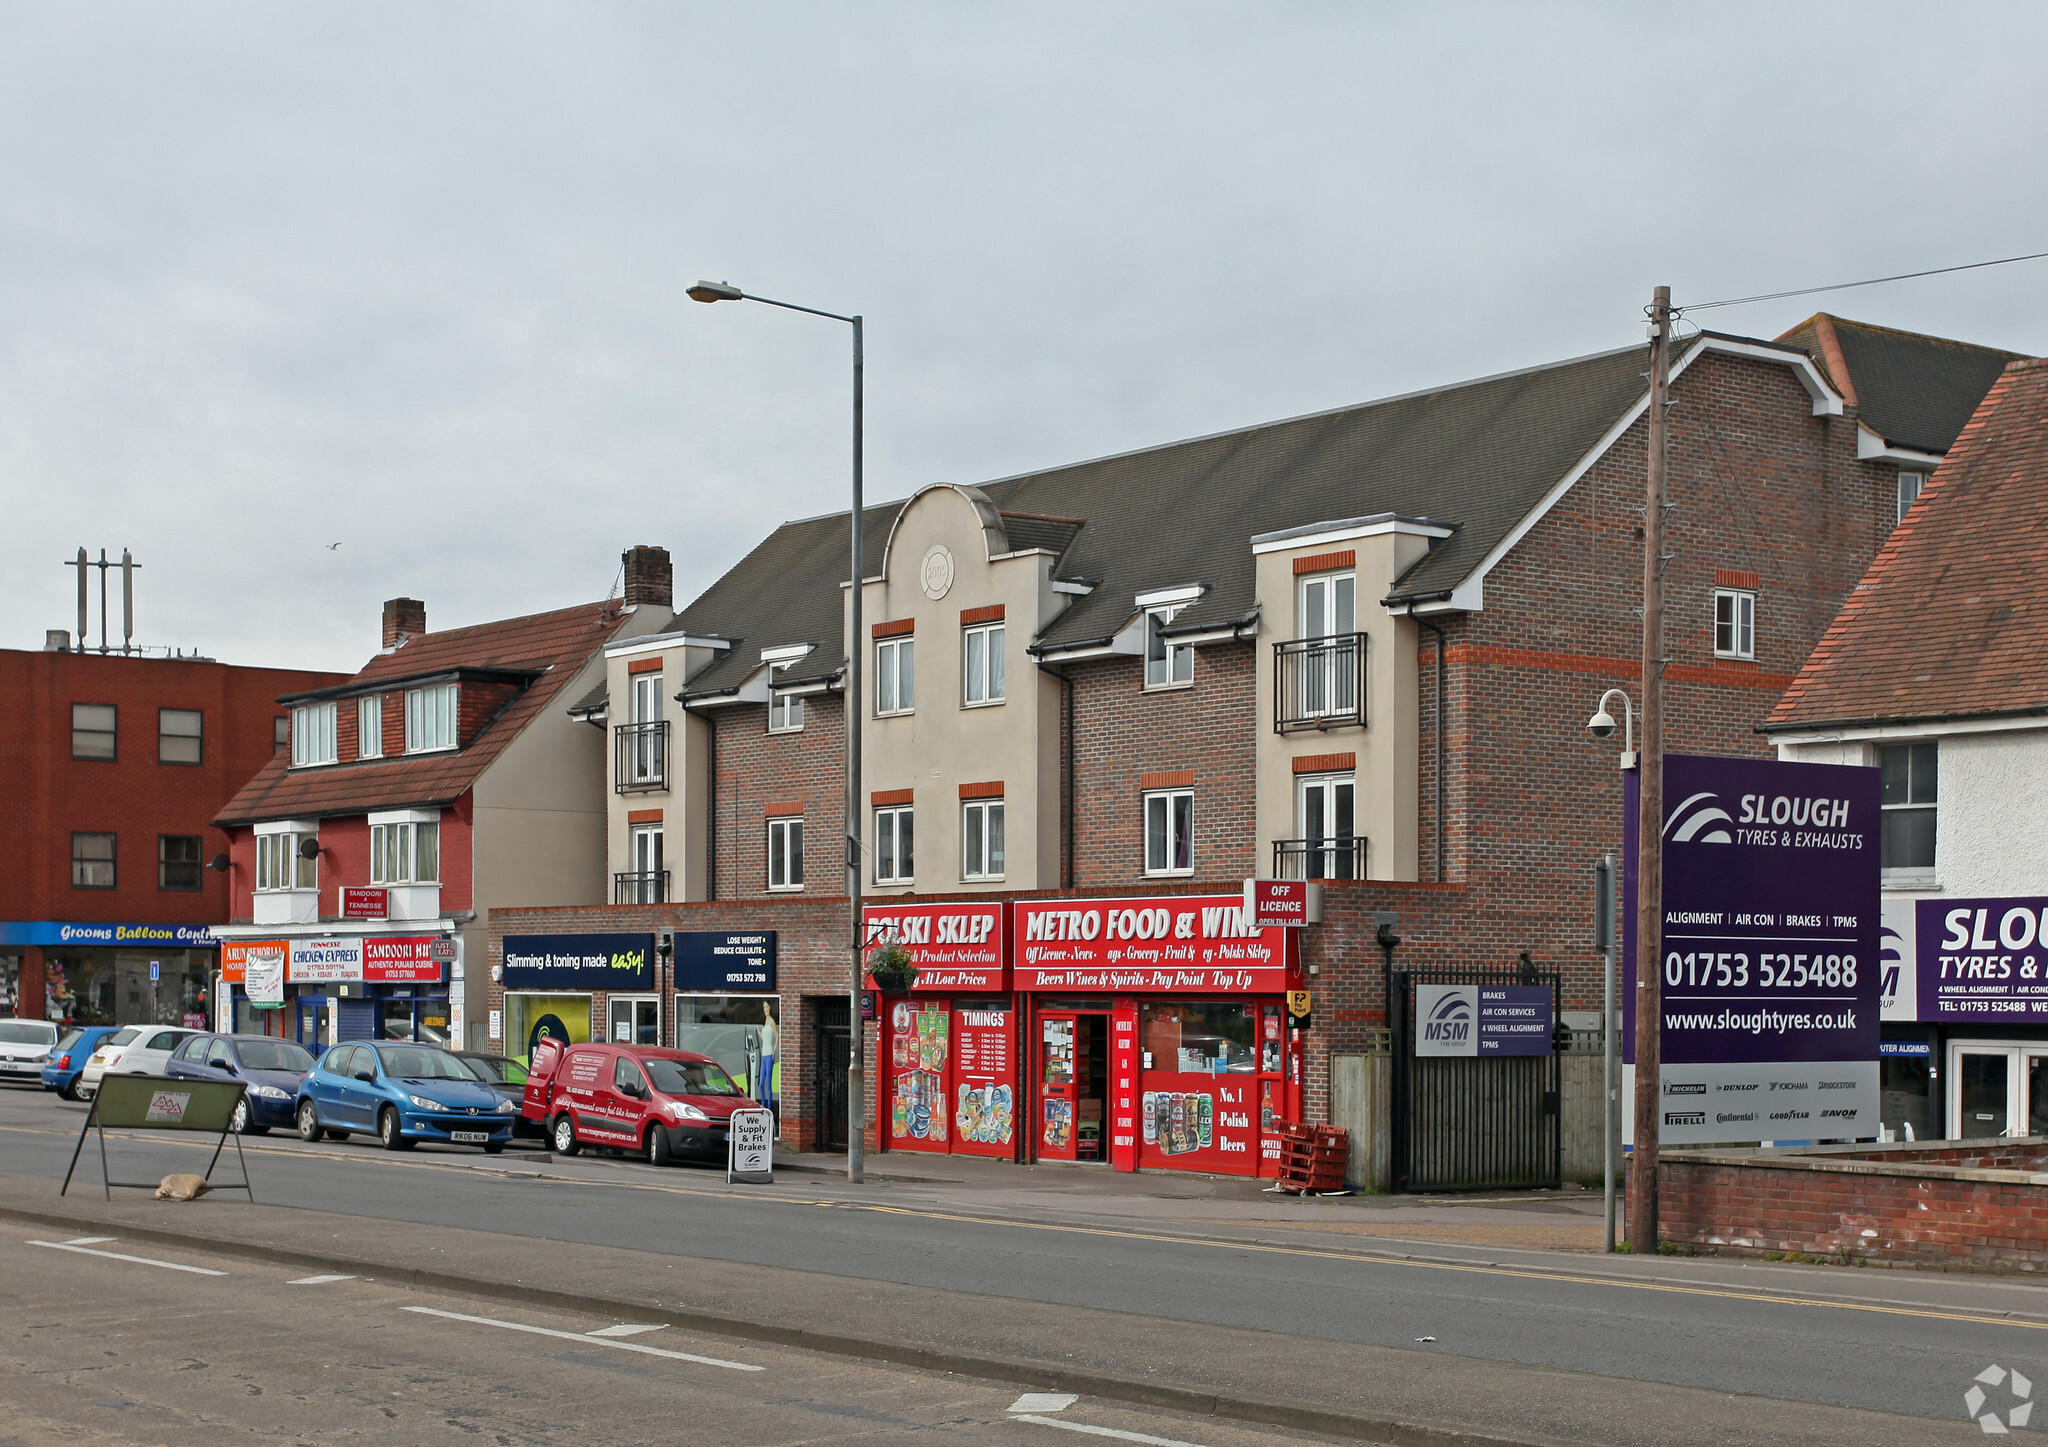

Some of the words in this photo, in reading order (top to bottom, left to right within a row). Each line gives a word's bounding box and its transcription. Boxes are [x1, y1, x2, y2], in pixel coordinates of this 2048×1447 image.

[1739, 794, 1850, 828] SLOUGH
[1736, 828, 1778, 846] TYRES
[1781, 831, 1790, 846] &
[1794, 831, 1863, 850] EXHAUSTS
[1271, 885, 1290, 896] OFF
[1260, 901, 1302, 912] LICENCE
[1026, 910, 1101, 941] METRO
[1106, 908, 1171, 940] FOOD
[1174, 912, 1196, 939] &
[1666, 912, 1723, 925] ALIGNMENT
[1735, 914, 1751, 925] AIR
[1754, 914, 1774, 925] CON
[1786, 915, 1821, 927] BRAKES
[1833, 916, 1857, 928] TPMS
[60, 925, 112, 941] Grooms
[116, 926, 174, 940] Balloon
[866, 916, 932, 945] POLSKI
[936, 915, 995, 944] SKLEP
[741, 936, 762, 944] WEIGHT
[227, 948, 246, 960] ARUN
[294, 950, 324, 963] CHICKEN
[325, 949, 358, 962] EXPRESS
[367, 944, 412, 958] TANDOORI
[735, 946, 762, 954] CELLULITE
[920, 950, 956, 962] Product
[956, 949, 996, 962] Selection
[1026, 947, 1039, 964] Off
[1038, 946, 1066, 960] Licence
[1071, 946, 1093, 960] News
[1127, 945, 1159, 963] Grocery
[1164, 944, 1187, 960] Fruit
[1187, 945, 1195, 962] &
[1218, 944, 1245, 959] Polski
[1246, 943, 1271, 963] Sklep
[506, 953, 543, 970] Slimming
[545, 954, 552, 967] &
[553, 953, 580, 970] toning
[582, 953, 607, 967] made
[611, 949, 645, 976] easy!
[748, 958, 762, 966] TONE
[1938, 956, 2012, 978] TYRES
[2020, 956, 2038, 978] &
[385, 970, 398, 978] 01753
[1665, 952, 1749, 987] 01753
[1760, 953, 1857, 988] 525488
[726, 974, 743, 982] 01753
[744, 974, 754, 982] 572
[935, 972, 956, 985] Low
[957, 972, 987, 985] Prices
[1036, 971, 1064, 985] Beers
[1066, 971, 1098, 985] Wines
[1099, 971, 1108, 988] &
[1109, 971, 1144, 989] Spirits
[1151, 971, 1173, 989] Pay
[1174, 971, 1205, 986] Point
[1212, 971, 1234, 990] Top
[1236, 971, 1253, 990] Up
[1482, 1008, 1492, 1016] AIR
[1494, 1008, 1507, 1016] CON
[1938, 1001, 1958, 1011] TEL:
[1960, 1001, 1988, 1011] 01753
[1991, 1001, 2026, 1011] 525488
[962, 1012, 1004, 1026] TIMINGS
[1665, 1008, 1856, 1034] www.sloughtyres.co.uk
[1425, 1022, 1469, 1040] MSM
[1779, 1082, 1808, 1090] YOKOHAMA
[1818, 1081, 1856, 1090] BRIDGESTONE
[1220, 1088, 1235, 1103] No.
[1238, 1088, 1242, 1102] 1
[1220, 1112, 1249, 1127] Polish
[1665, 1112, 1705, 1125] PIRELLI
[1716, 1112, 1753, 1123] Continental
[1829, 1109, 1857, 1117] AVON
[738, 1125, 766, 1134] Supply
[753, 1134, 763, 1142] Fit
[1220, 1136, 1246, 1152] Beers
